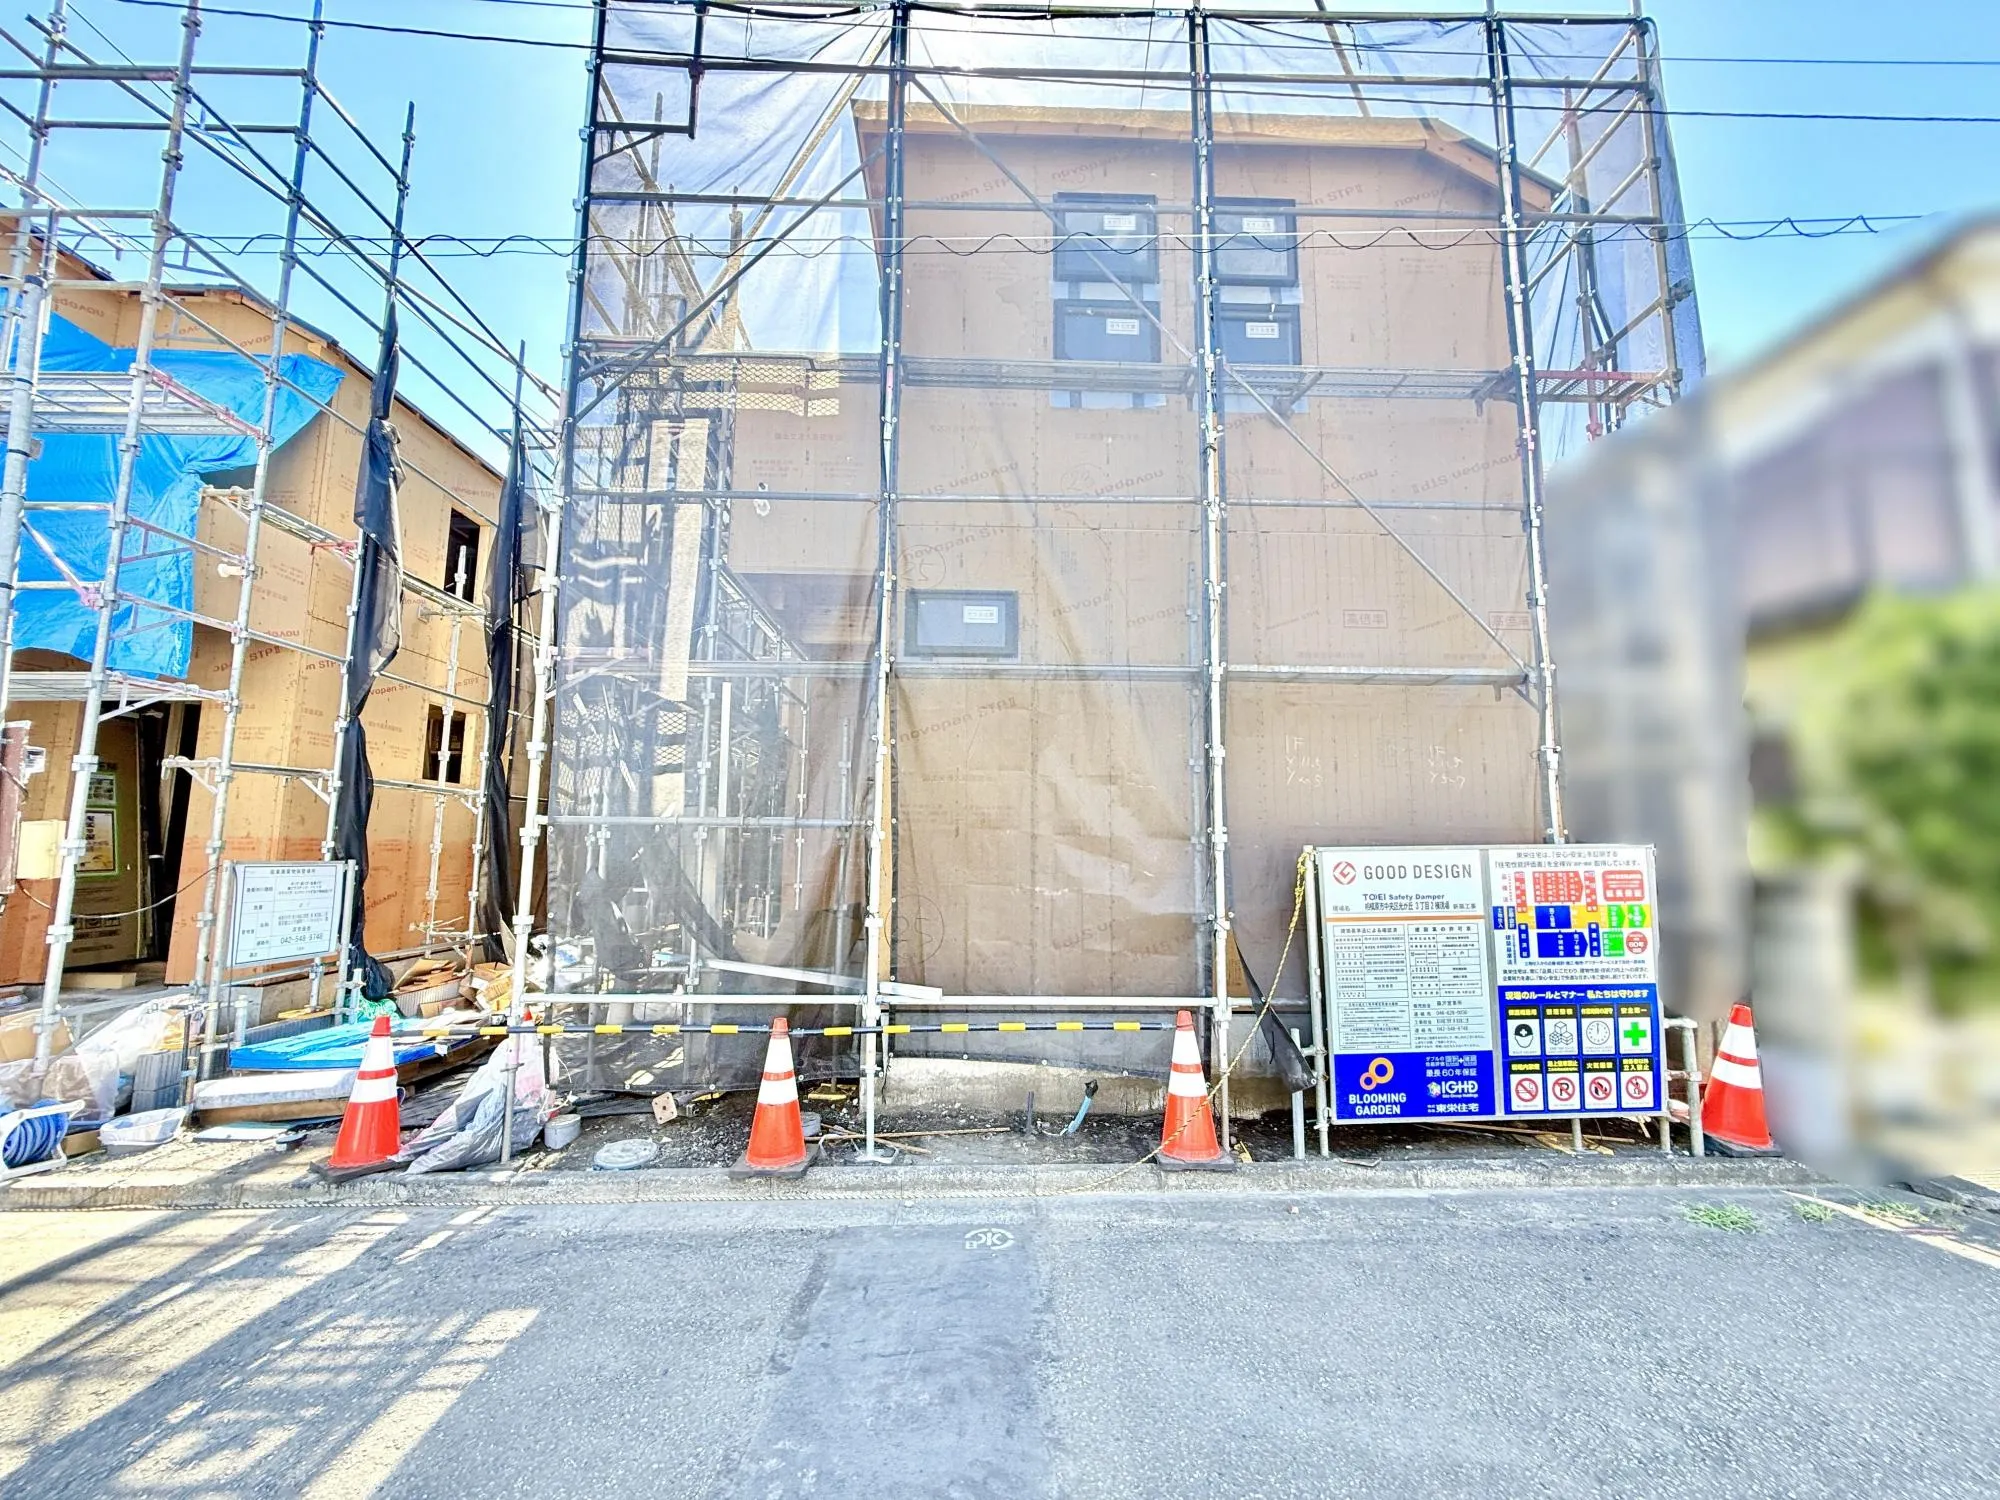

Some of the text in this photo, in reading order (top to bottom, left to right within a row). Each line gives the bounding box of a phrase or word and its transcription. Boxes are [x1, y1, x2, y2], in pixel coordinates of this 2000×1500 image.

[1346, 612, 1386, 626] 高倍率
[899, 713, 974, 743] novopan
[1364, 864, 1472, 880] GOOD DESIGN
[1388, 893, 1413, 902] Safety
[1415, 893, 1445, 902] Damper
[1505, 989, 1649, 1000] 現場のルールとマナー 私たちは守ります
[1426, 1068, 1477, 1077] 最長60年保証
[1348, 1093, 1407, 1105] BLOOMING
[1355, 1105, 1401, 1116] GARDEN
[1436, 1103, 1479, 1113] 東栄住宅
